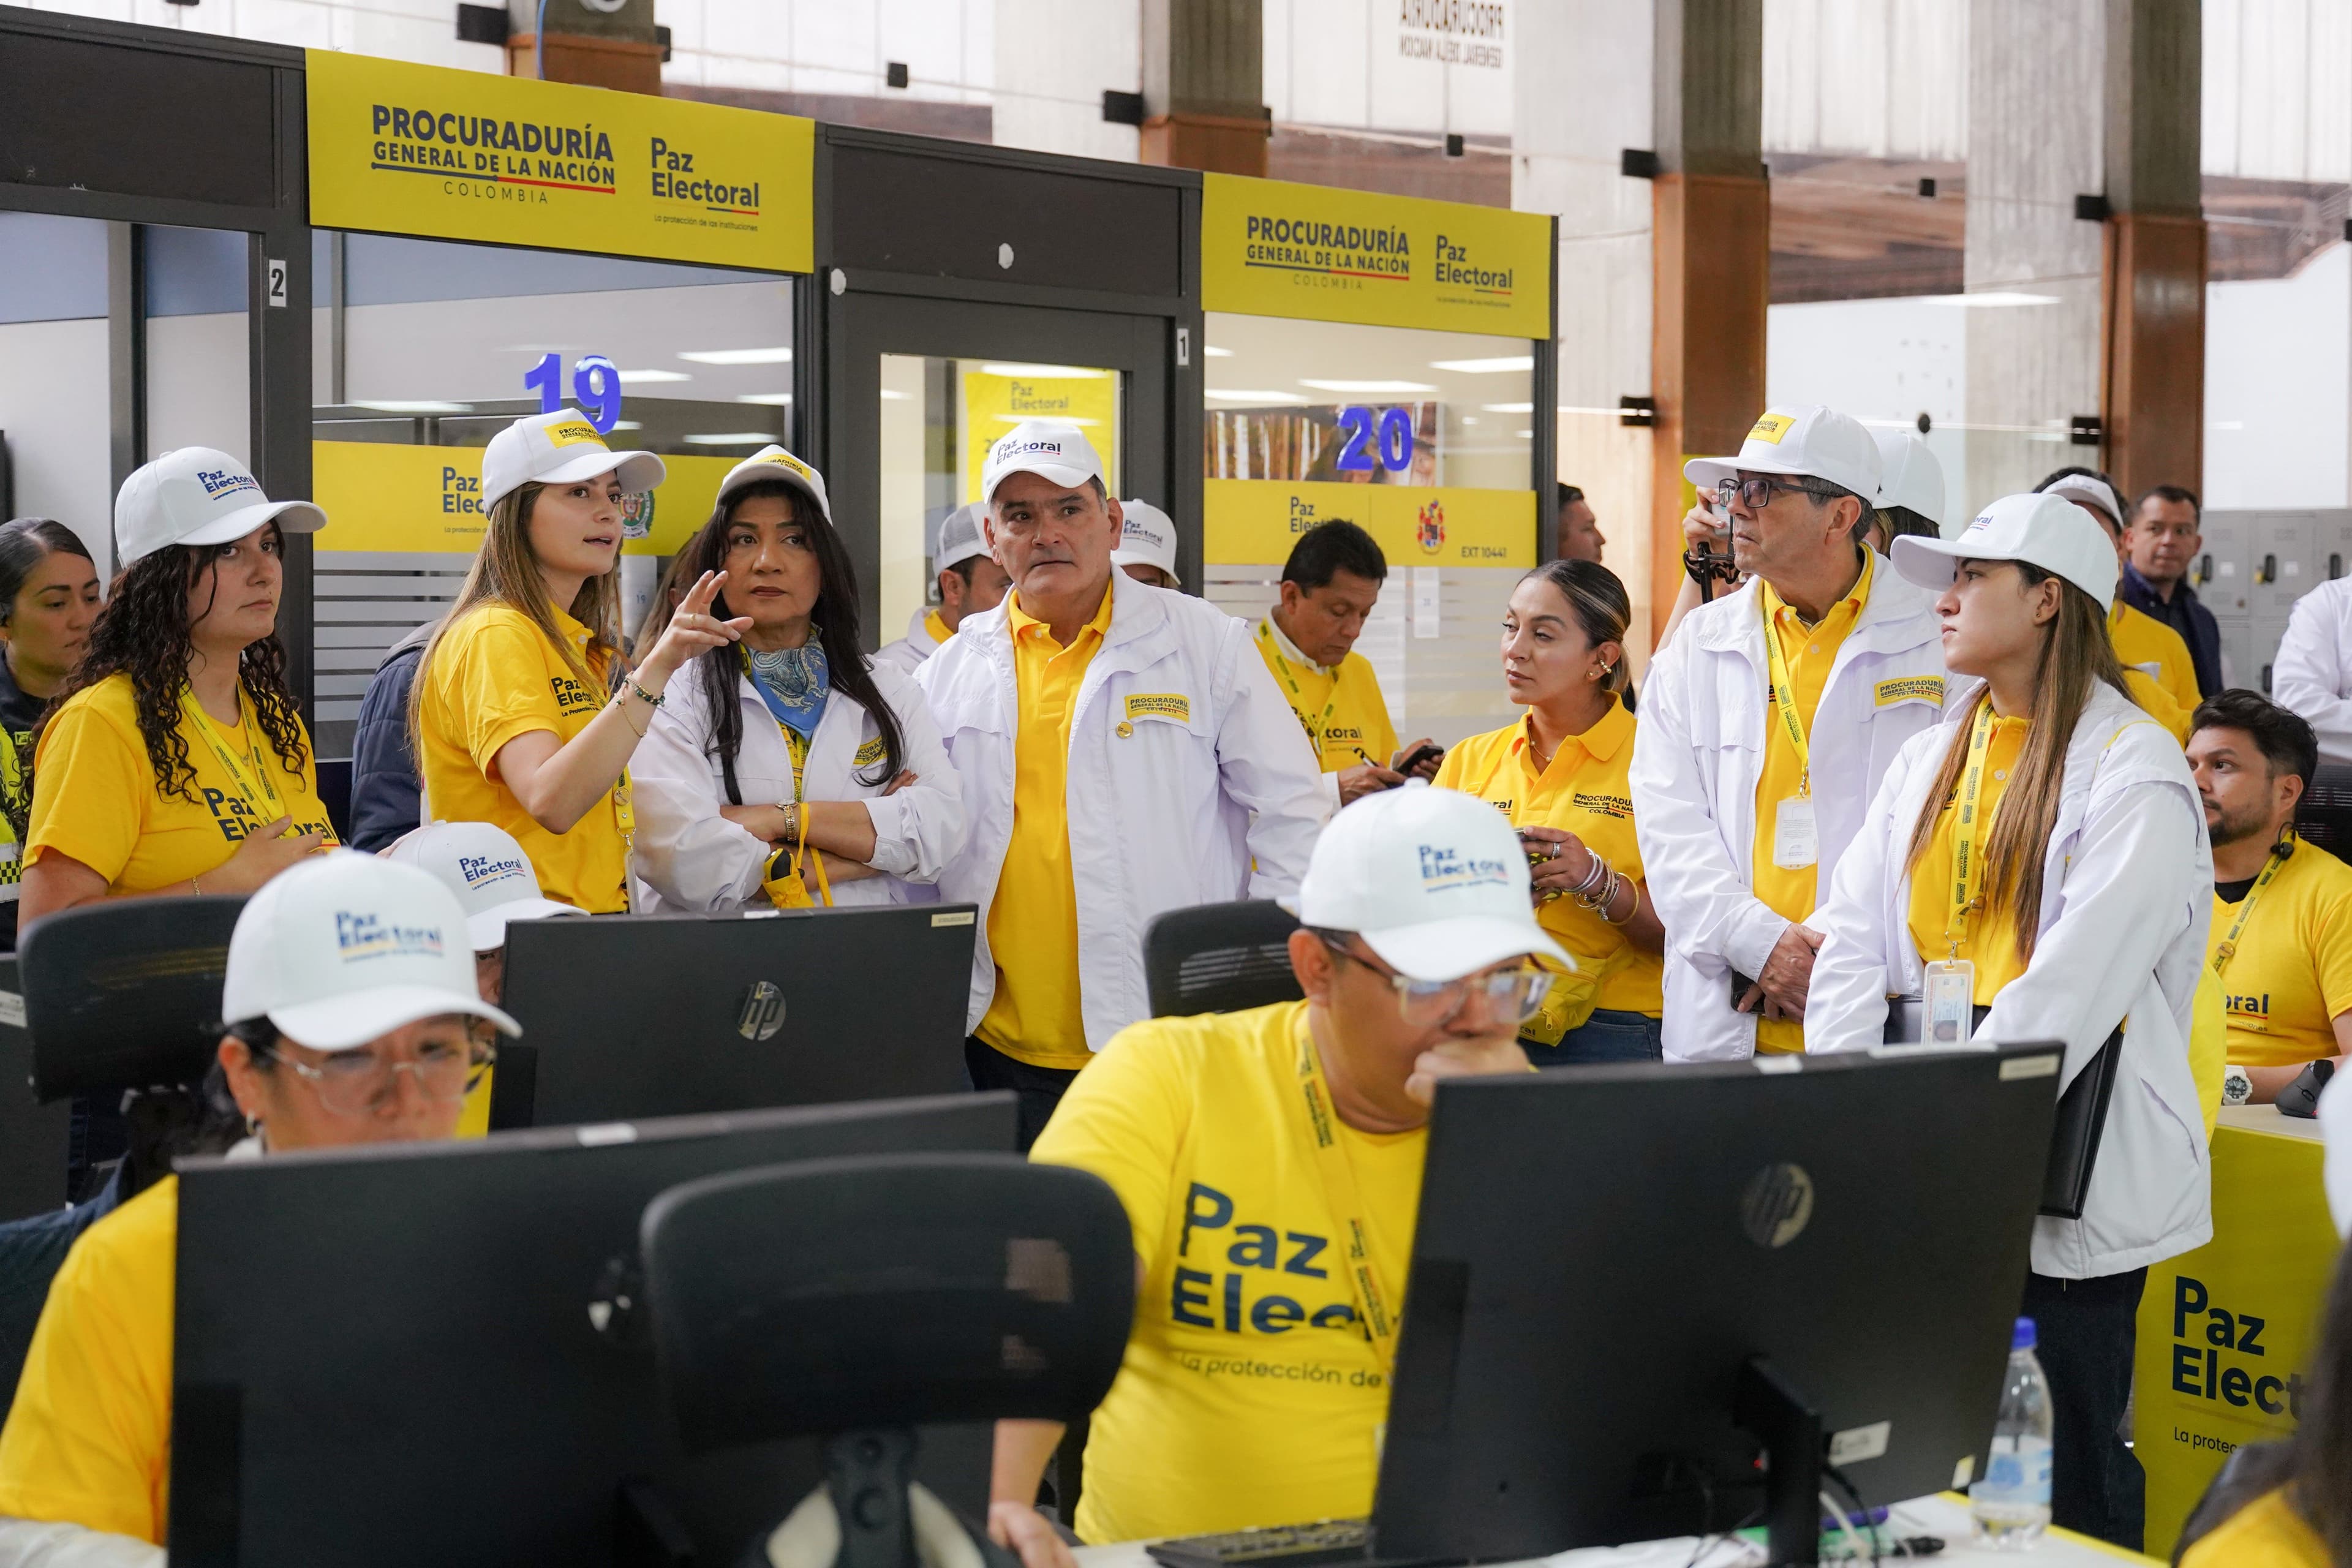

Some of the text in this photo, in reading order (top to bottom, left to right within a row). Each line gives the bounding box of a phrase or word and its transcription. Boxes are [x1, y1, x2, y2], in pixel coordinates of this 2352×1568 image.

[372, 105, 614, 162] PROCURADURÍA
[374, 141, 614, 184] GENERAL DE LA NACIÓN
[651, 137, 693, 173] Paz
[444, 181, 548, 203] COLOMBIA
[652, 172, 759, 207] Electoral
[663, 216, 697, 226] protección
[720, 221, 758, 232] instituciones
[1247, 216, 1409, 255] PROCURADURÍA
[1436, 235, 1466, 262] Paz
[1247, 245, 1409, 273] GENERAL DE LA NACIÓN
[271, 268, 284, 296] 2
[1293, 274, 1363, 290] COLOMBIA
[1436, 263, 1512, 288] Electoral
[1180, 336, 1186, 357] 1
[525, 353, 622, 434] 19
[1011, 382, 1033, 396] Paz
[1011, 397, 1069, 410] Electoral
[998, 439, 1017, 456] Paz
[1337, 407, 1414, 471] 20
[997, 441, 1061, 466] Electoral
[197, 470, 225, 484] Paz
[204, 475, 255, 494] Electoral
[443, 467, 478, 491] Paz
[443, 493, 484, 513] Elec
[1291, 497, 1314, 515] Paz
[1125, 520, 1140, 529] Paz
[1123, 529, 1163, 543] Electoral
[1461, 547, 1479, 557] EXT
[551, 677, 581, 694] Paz
[1880, 680, 1943, 692] PROCURADURÍA
[1881, 687, 1905, 696] GENERAL
[1926, 686, 1943, 695] NACIÓN
[1131, 698, 1188, 707] PROCURADURÍA
[202, 788, 255, 816] Paz
[1575, 793, 1633, 807] PROCURADU
[1589, 809, 1625, 819] COLOMBIA
[1420, 846, 1454, 862] Paz
[459, 857, 488, 872] Paz
[464, 859, 522, 882] Electoral
[1422, 859, 1506, 878] Electoral
[739, 984, 780, 1039] hp
[1180, 1182, 1328, 1278] Paz
[2174, 1276, 2265, 1356] Paz
[1206, 1352, 1341, 1384] protección
[1350, 1368, 1381, 1387] de
[2174, 1427, 2189, 1442] La
